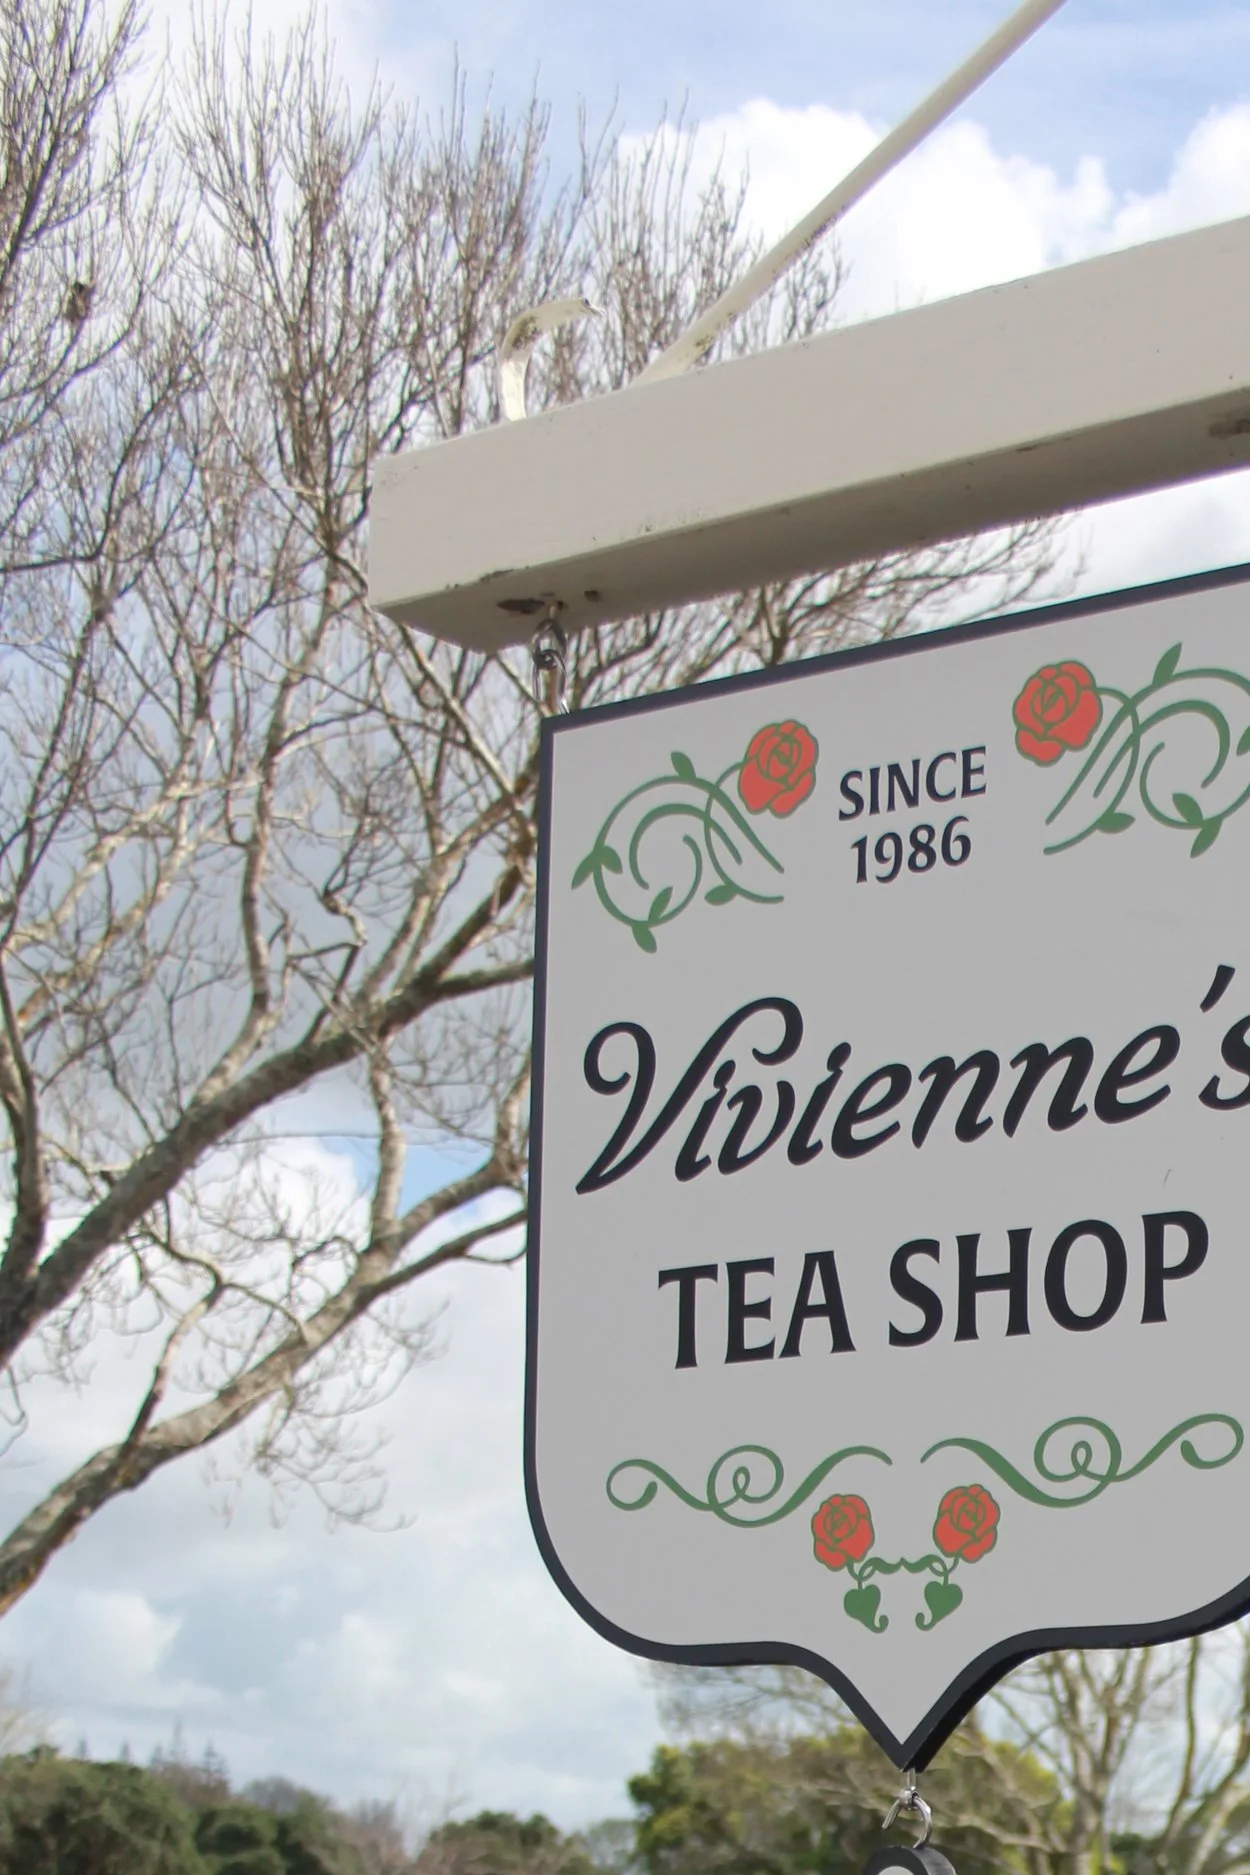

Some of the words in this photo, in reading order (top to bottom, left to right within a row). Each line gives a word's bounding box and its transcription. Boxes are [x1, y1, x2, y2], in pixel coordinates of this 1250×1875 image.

[838, 745, 987, 821] SINCE
[851, 815, 972, 884] 1986
[657, 1250, 857, 1370] TEA
[888, 1210, 1209, 1348] SHOP
